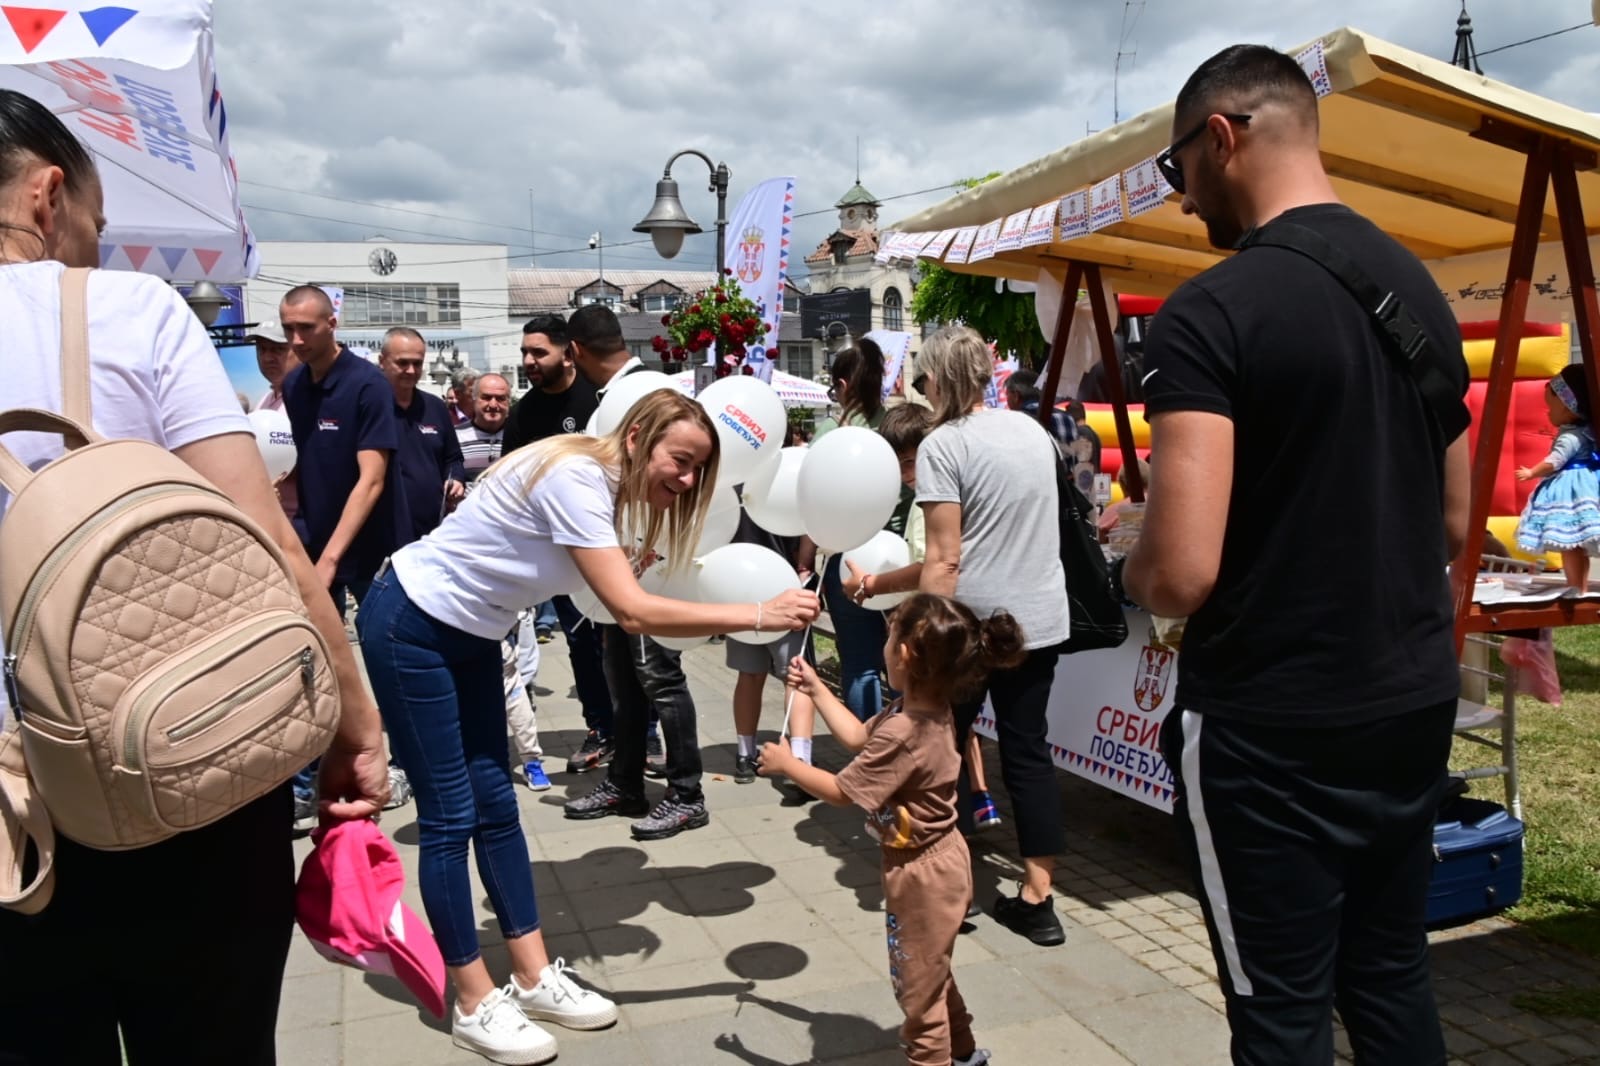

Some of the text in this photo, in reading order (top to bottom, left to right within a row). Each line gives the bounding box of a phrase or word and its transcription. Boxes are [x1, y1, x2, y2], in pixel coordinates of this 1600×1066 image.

[718, 412, 761, 451] ПОБЕЂУЈЕ
[725, 404, 767, 443] СРБИЈА
[1096, 706, 1162, 754] СРБИ
